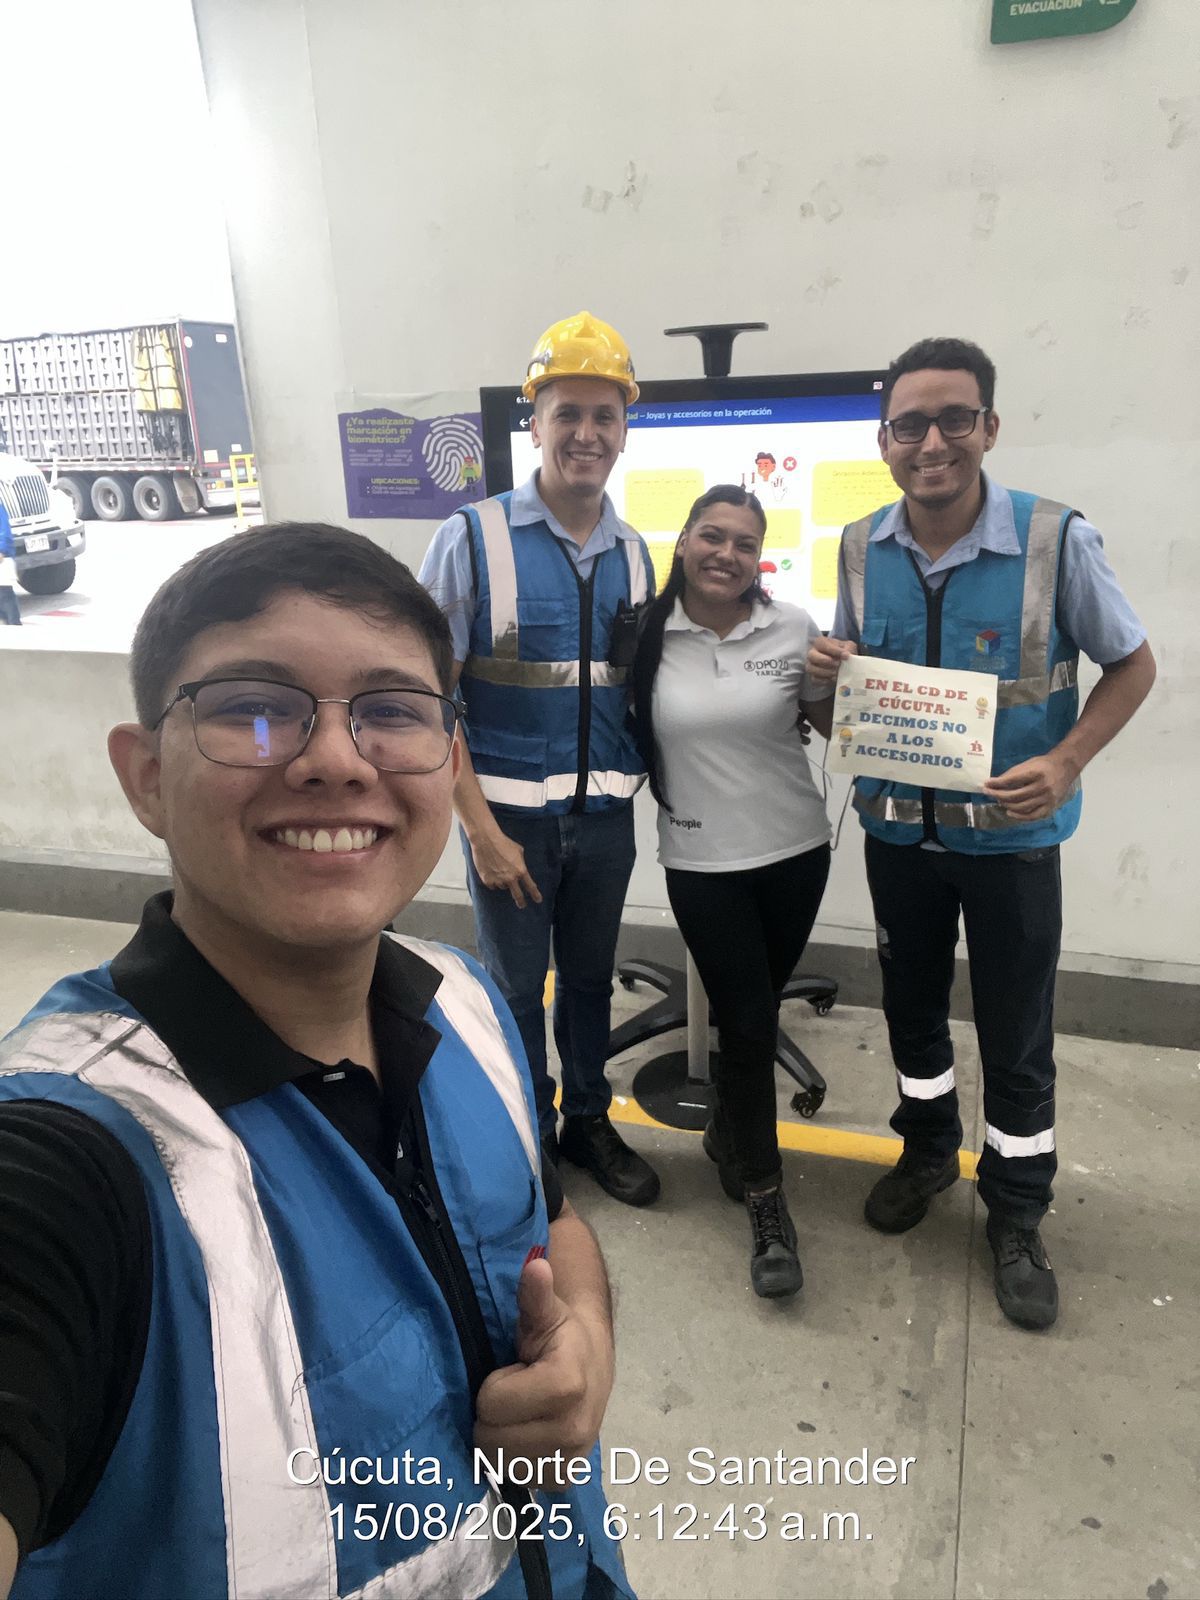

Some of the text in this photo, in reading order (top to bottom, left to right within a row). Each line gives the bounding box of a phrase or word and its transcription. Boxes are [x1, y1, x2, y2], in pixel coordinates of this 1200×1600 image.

[646, 411, 666, 421] Joyas
[667, 412, 672, 421] y
[673, 410, 712, 418] accesorios
[713, 410, 723, 418] en
[725, 408, 733, 416] la
[733, 406, 772, 418] operación
[865, 678, 968, 701] EN EL CD DE
[878, 695, 951, 716] CÚCUTA:
[859, 711, 938, 731] DECIMOS
[942, 721, 967, 735] NO
[886, 732, 934, 748] A LOS
[855, 744, 964, 769] ACCESORIOS
[669, 816, 702, 830] People
